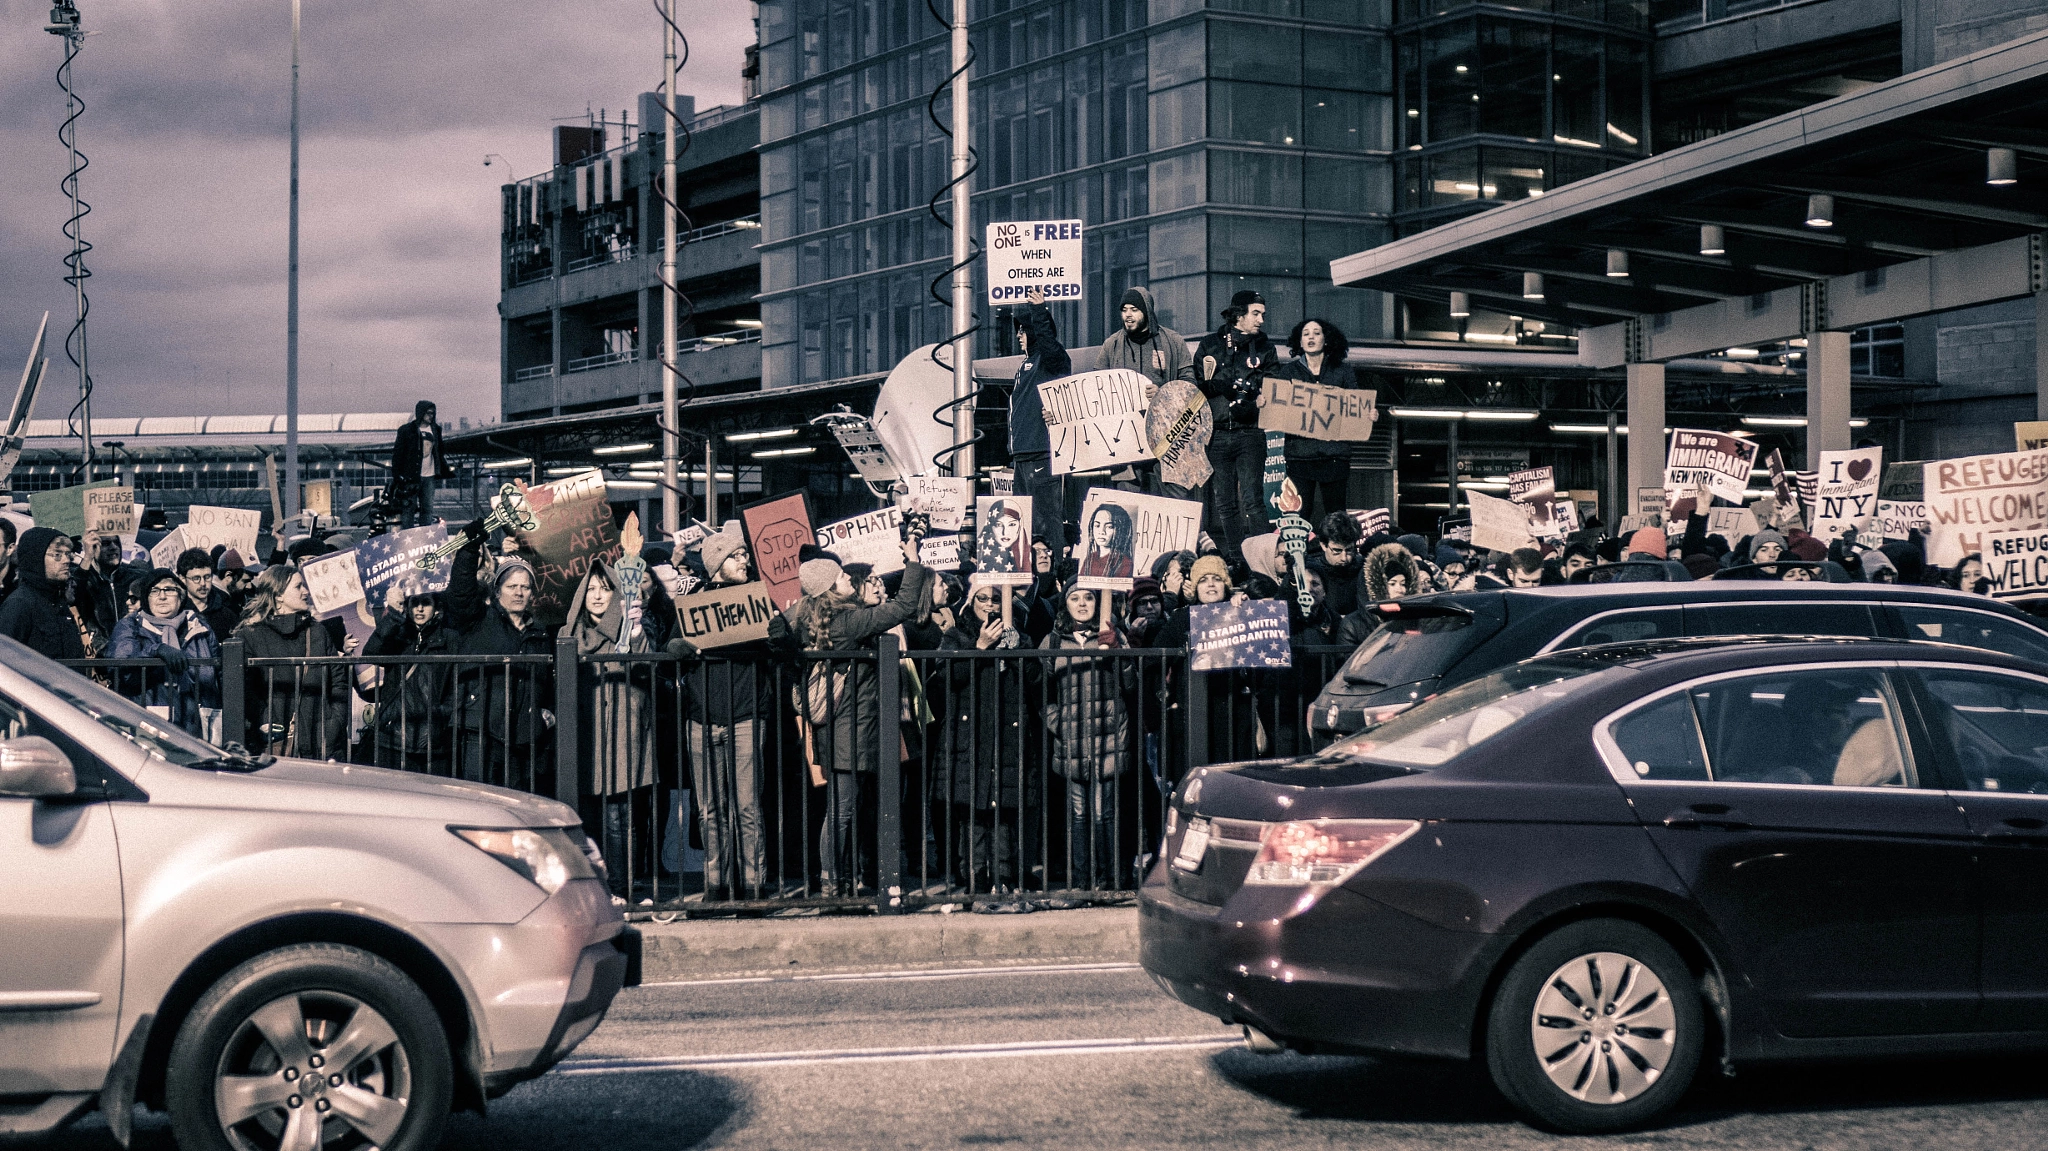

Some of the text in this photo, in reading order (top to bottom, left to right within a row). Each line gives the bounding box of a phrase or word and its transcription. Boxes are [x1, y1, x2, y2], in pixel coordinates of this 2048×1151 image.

[997, 223, 1081, 240] NO IS FREE
[994, 235, 1022, 249] ONE
[1021, 249, 1052, 260] WHEN
[1008, 267, 1065, 279] OTHERS ARE
[1271, 382, 1372, 419] LET THEM
[1165, 407, 1194, 444] CAUTION
[1300, 409, 1335, 434] IN
[1161, 409, 1203, 469] HUMANITY
[1681, 434, 1718, 447] We are
[1265, 454, 1287, 467] eserve
[1671, 448, 1750, 481] IMMIGRANT
[1509, 468, 1550, 483] CAPITALISM
[1670, 470, 1716, 487] NEW YORK
[1829, 461, 1843, 483] I
[919, 479, 958, 498] Refugees
[1510, 484, 1524, 493] HAS
[1820, 474, 1878, 498] Immigrant
[88, 491, 133, 504] RELEASE
[929, 498, 943, 506] Are
[1820, 493, 1873, 518] NY
[99, 505, 131, 515] THEM
[1895, 505, 1926, 518] NYC
[1932, 491, 2047, 525] WELCOME
[96, 518, 131, 532] NOW!
[190, 509, 254, 528] NO BAN
[931, 515, 949, 524] here
[1361, 515, 1382, 529] PLEDGE
[1622, 517, 1637, 531] NO
[1715, 511, 1743, 530] LET
[570, 521, 613, 552] ARE
[816, 509, 898, 549] STOP HATE
[188, 535, 211, 550] NO
[762, 529, 804, 554] STOP
[922, 541, 942, 550] UGEE
[366, 543, 438, 577] I STAND WITH
[773, 555, 797, 575] HAT
[678, 594, 771, 637] LET THEM IN
[1201, 619, 1279, 640] I STAND WITH
[1196, 629, 1285, 650] #IMMIGRANTNY
